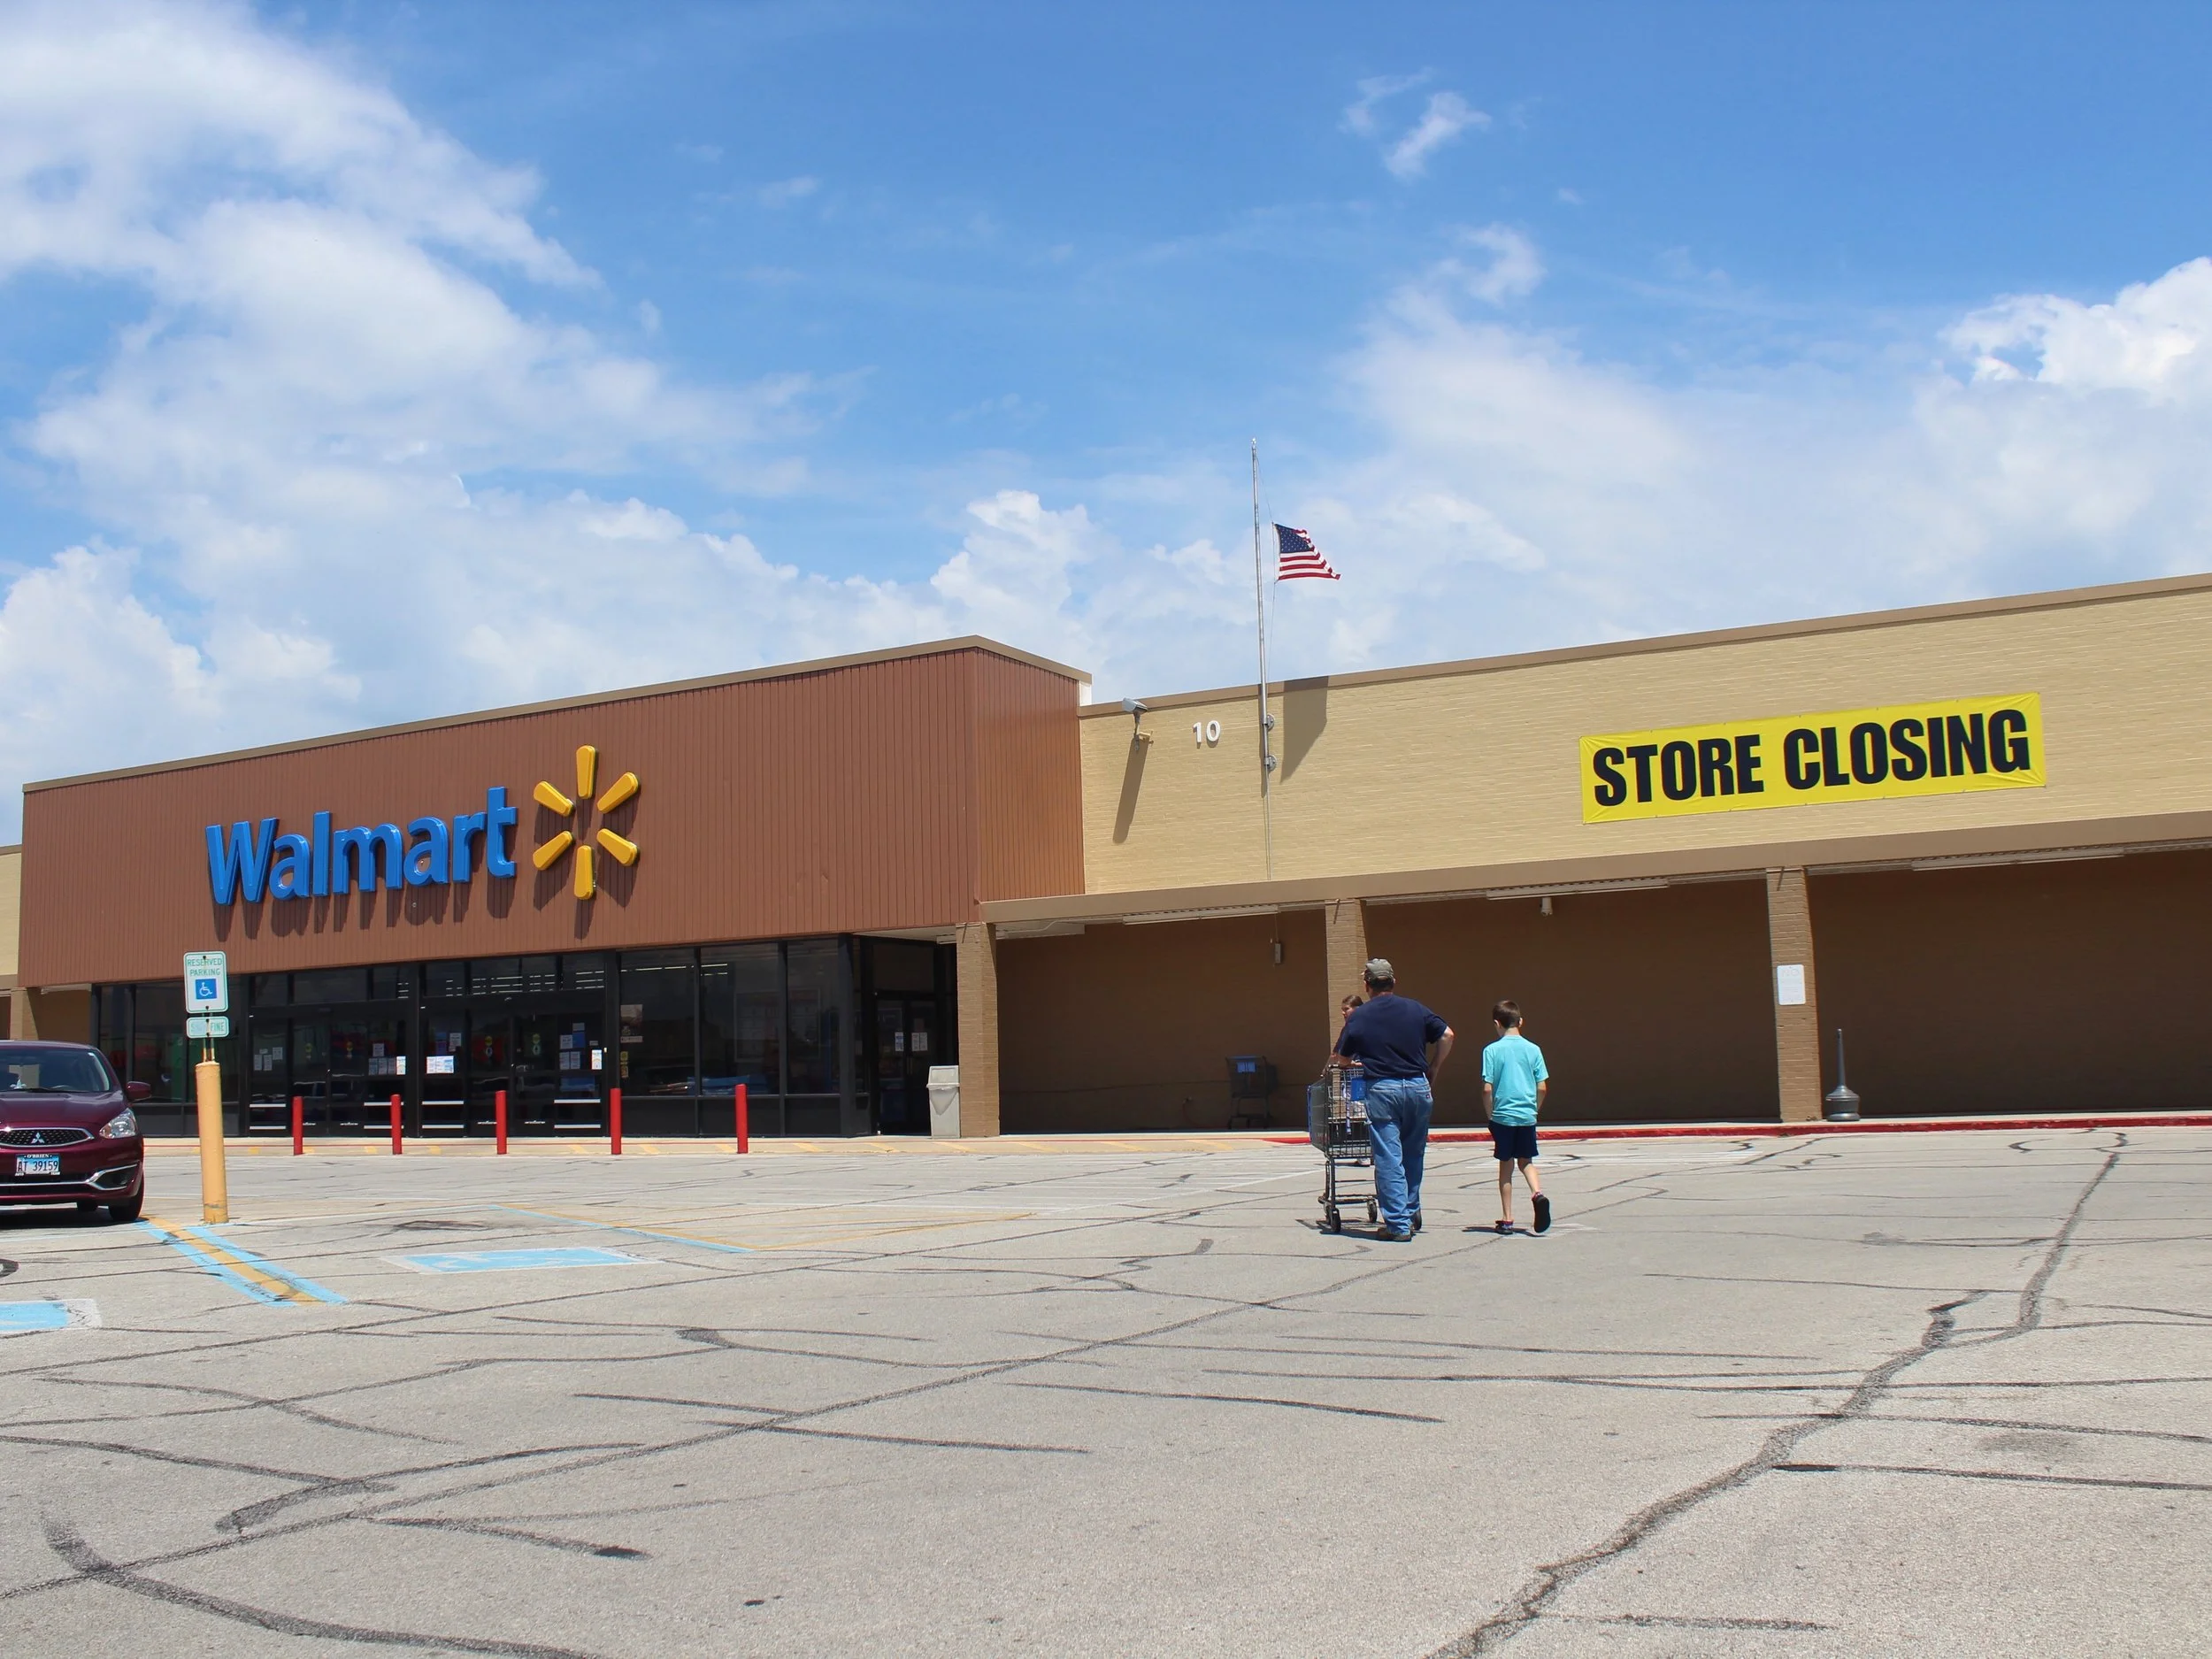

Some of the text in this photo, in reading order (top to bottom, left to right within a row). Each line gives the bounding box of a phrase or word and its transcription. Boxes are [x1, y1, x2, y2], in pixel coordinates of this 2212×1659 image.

[1192, 719, 1221, 744] 10
[1593, 709, 2032, 807] STORE CLOSING
[205, 786, 518, 906] Walmart
[189, 968, 221, 977] PARKING
[210, 1022, 225, 1033] FINE
[33, 1160, 58, 1171] 39159
